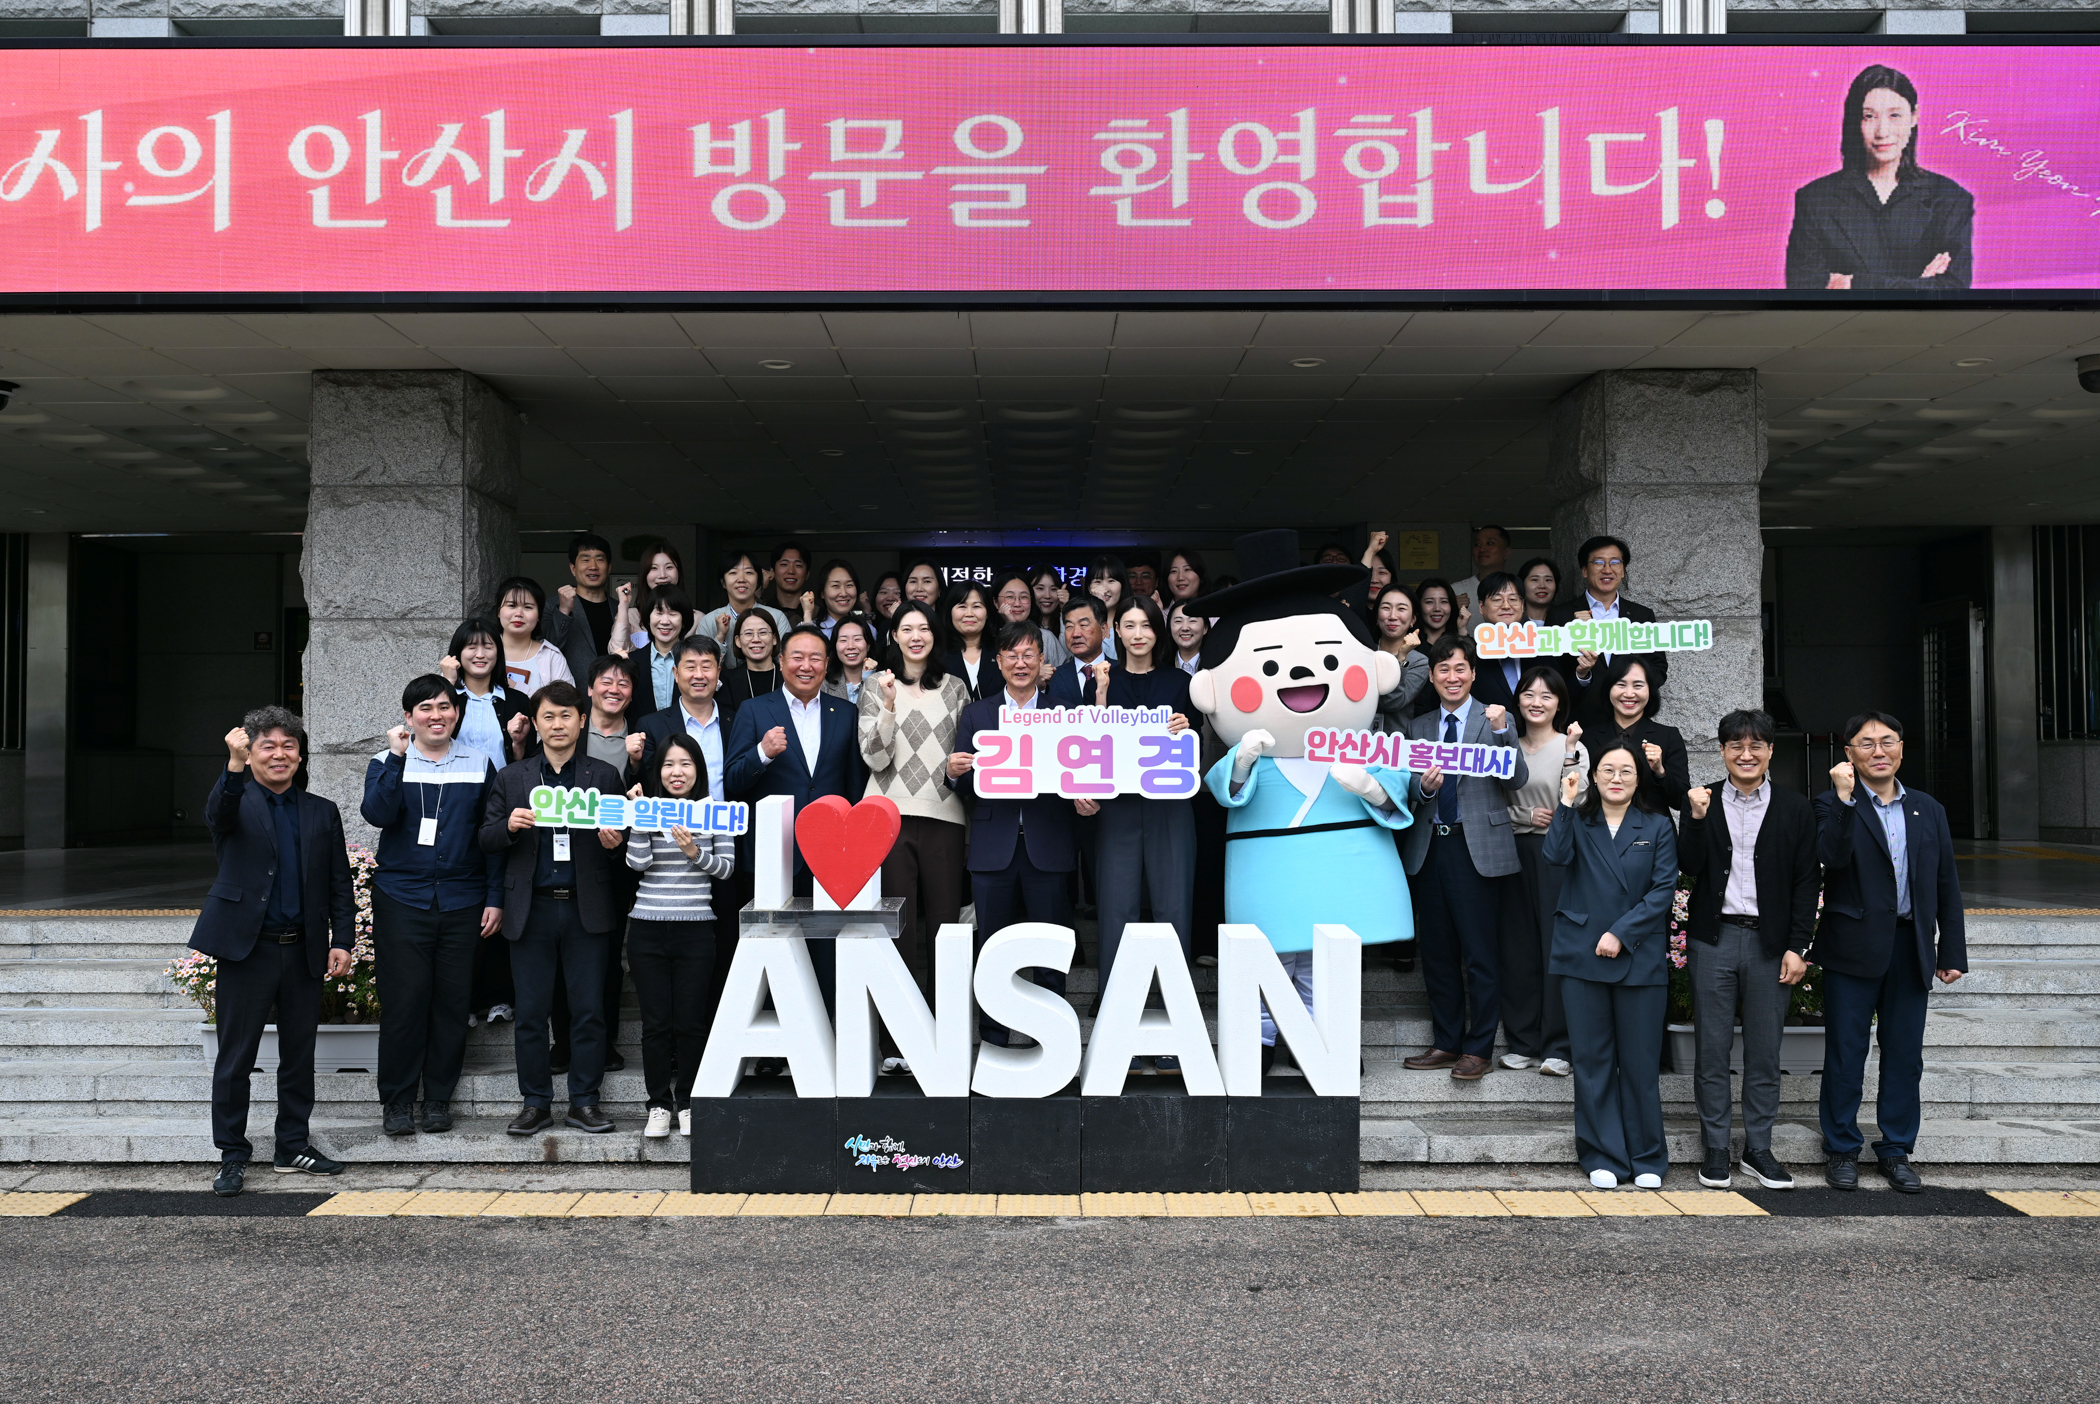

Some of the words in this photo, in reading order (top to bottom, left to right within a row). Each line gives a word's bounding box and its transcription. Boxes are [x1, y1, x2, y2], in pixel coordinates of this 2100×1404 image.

[1940, 110, 2012, 157] Kim
[0, 108, 231, 232] 사의
[288, 108, 633, 232] 안산시
[686, 107, 1050, 230] 방문을
[1088, 106, 1726, 230] 환영합니다!
[1477, 623, 1562, 655] 안산과
[1568, 620, 1709, 652] 함께합니다!
[1002, 708, 1061, 726] Legend
[1067, 708, 1084, 724] of
[1089, 708, 1169, 727] Volleyball
[1307, 730, 1401, 767] 안산시
[1408, 742, 1512, 776] 홍보대사
[533, 788, 624, 826] 안산을
[634, 799, 745, 832] 알립니다!
[754, 795, 794, 909] I
[690, 922, 1362, 1098] ANSAN
[844, 1134, 881, 1157] 시민과
[932, 1152, 964, 1169] 안산
